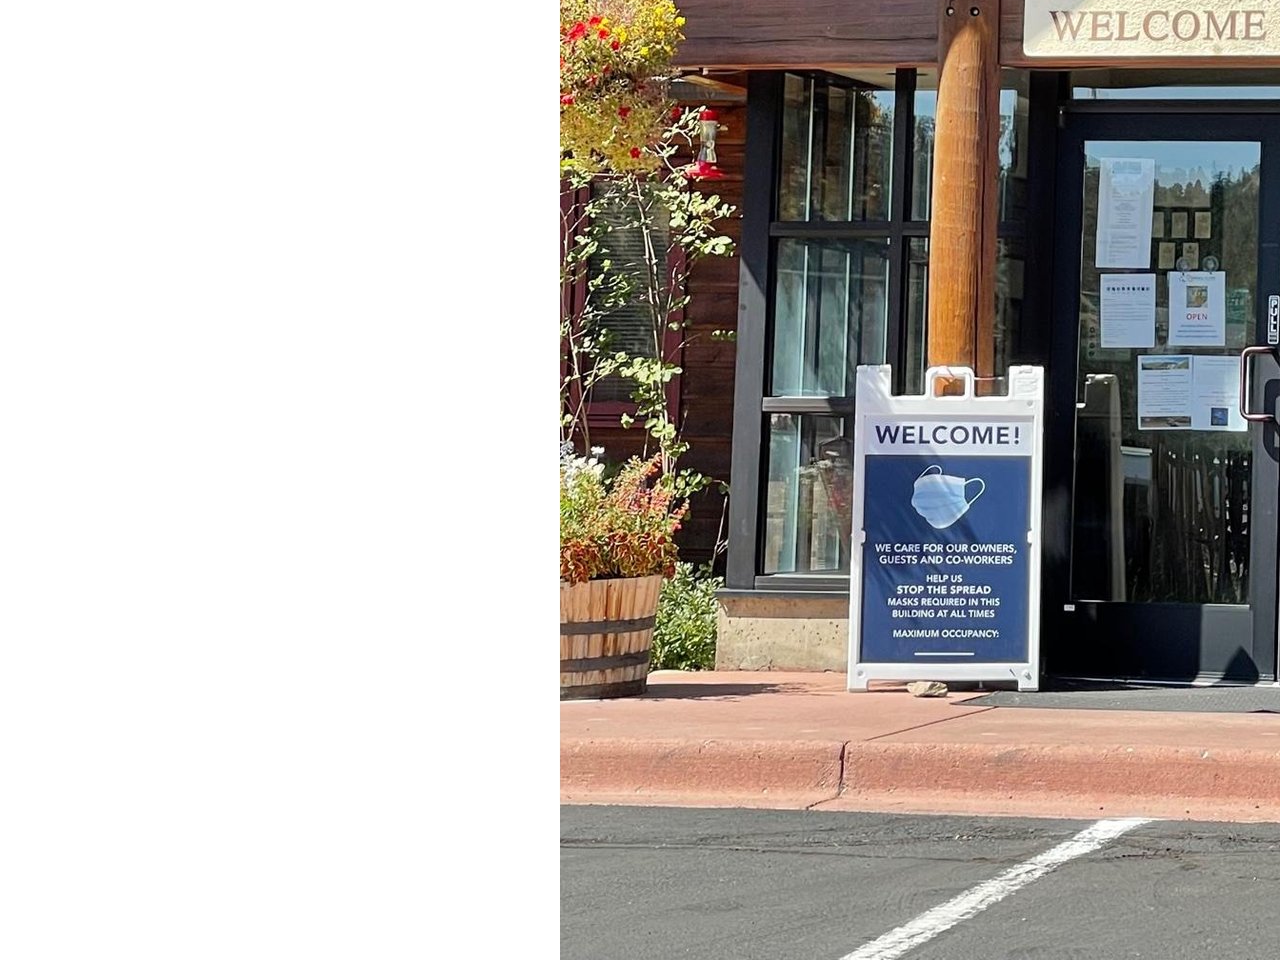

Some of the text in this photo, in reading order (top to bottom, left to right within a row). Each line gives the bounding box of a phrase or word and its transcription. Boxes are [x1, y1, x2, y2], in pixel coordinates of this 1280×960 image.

[1049, 9, 1267, 43] WELCOME
[1186, 313, 1208, 321] OPEN
[1269, 298, 1279, 333] PULL
[875, 425, 1020, 445] WELCOME!
[875, 543, 1018, 554] WE CARE FOR OUR OWNERS,
[879, 555, 1013, 565] GUESTS AND CO-WORKERS
[926, 574, 963, 583] HELP US
[897, 585, 992, 595] STOP THE SPREAD
[888, 598, 1000, 607] MASKS REQUIRED IN THIS
[892, 609, 995, 618] BUILDING AT ALL TIMES
[893, 629, 999, 639] MAXIMUM OCCUPANCY:
